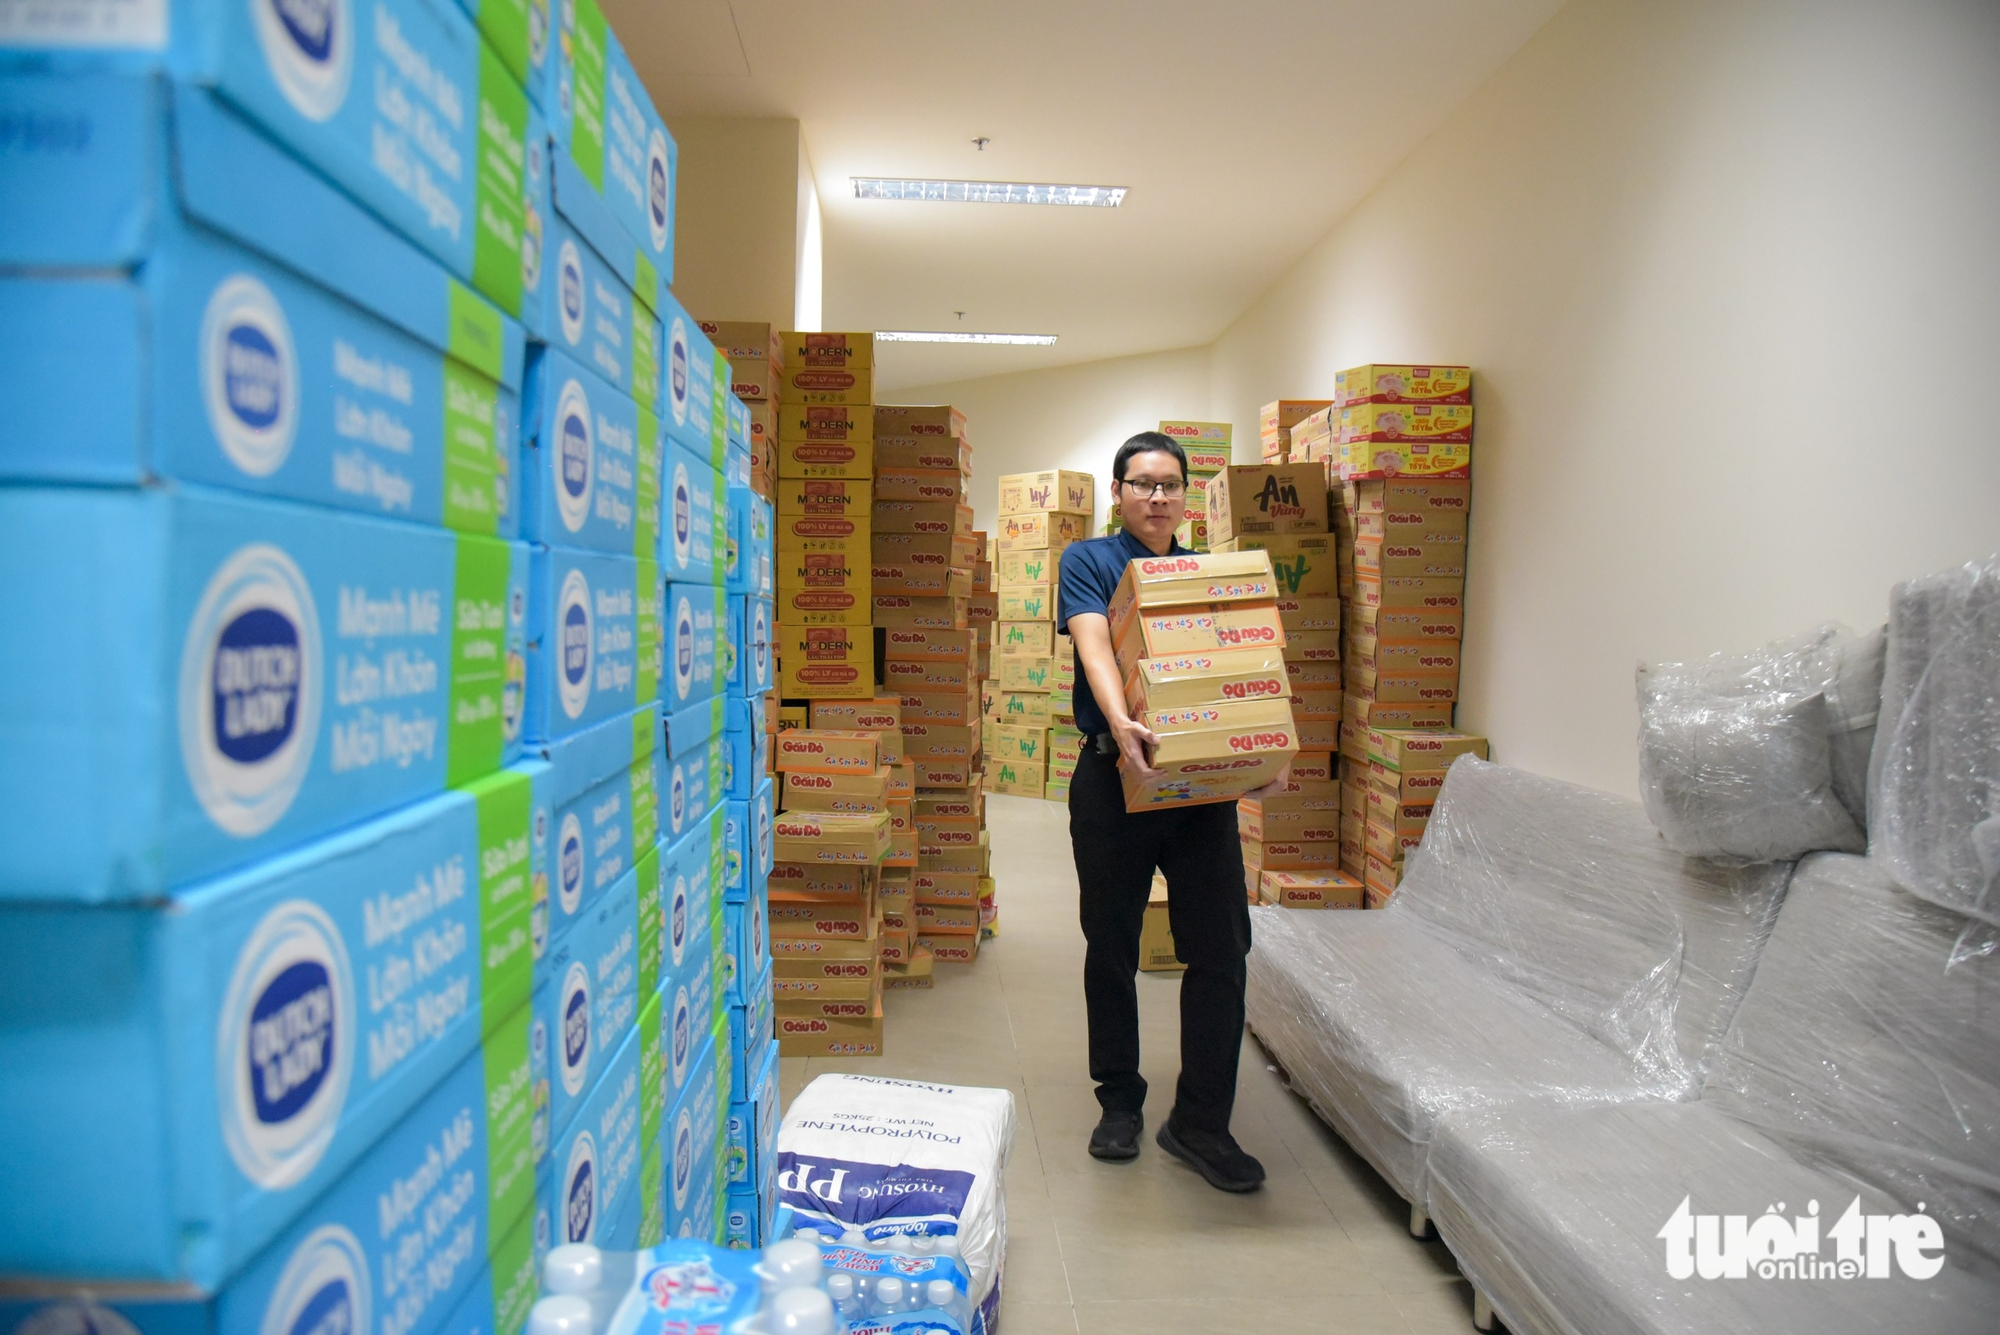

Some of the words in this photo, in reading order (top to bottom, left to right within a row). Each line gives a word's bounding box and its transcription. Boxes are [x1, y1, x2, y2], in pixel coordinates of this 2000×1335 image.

[799, 347, 852, 356] MODERN
[800, 420, 853, 430] MODERN
[1164, 426, 1184, 435] Gấu
[1186, 426, 1198, 436] Đỏ
[798, 450, 817, 458] 100%
[1192, 456, 1204, 466] Đỏ
[1206, 458, 1225, 466] Gấu
[1254, 474, 1300, 512] An
[798, 494, 850, 504] MODERN
[1430, 498, 1440, 506] Đỏ
[1444, 498, 1463, 507] Gấu
[1184, 510, 1205, 520] Gấu
[1388, 514, 1408, 523] Gấu
[1410, 514, 1422, 523] Đỏ
[1387, 548, 1407, 556] Gấu
[1409, 548, 1421, 556] Đỏ
[1142, 560, 1176, 574] Gấu
[1177, 558, 1199, 571] Đỏ
[798, 568, 851, 577] MODERN
[1208, 587, 1222, 596] Gà
[1226, 585, 1242, 595] Sợi
[1245, 583, 1266, 593] Phở
[1152, 621, 1173, 631] Phở
[1176, 619, 1193, 628] Sợi
[1197, 618, 1211, 628] Gà
[891, 633, 912, 643] Gấu
[912, 632, 925, 643] Đỏ
[1218, 630, 1241, 643] Đỏ
[1241, 627, 1275, 641] Gấu
[800, 642, 852, 650] MODERN
[1150, 662, 1172, 672] Phở
[1175, 659, 1192, 669] Sợi
[1196, 658, 1211, 668] Gà
[217, 644, 298, 698] DUTCH
[890, 664, 910, 673] Gấu
[911, 664, 924, 674] Đỏ
[1222, 683, 1245, 698] Đỏ
[1246, 679, 1281, 696] Gấu
[224, 693, 291, 738] LADY
[1156, 715, 1178, 726] Phở
[1181, 712, 1199, 722] Sợi
[1203, 711, 1218, 720] Gà
[858, 716, 873, 726] Đỏ
[875, 716, 894, 726] Gấu
[1229, 736, 1252, 752] Đỏ
[1254, 732, 1288, 748] Gấu
[783, 741, 808, 753] Gấu
[808, 742, 824, 753] Đỏ
[1407, 741, 1427, 750] Gấu
[1429, 741, 1442, 749] Đỏ
[791, 777, 813, 788] Gấu
[814, 777, 832, 788] Đỏ
[1409, 778, 1429, 787] Gấu
[1430, 777, 1443, 786] Đỏ
[777, 824, 803, 836] Gấu
[804, 824, 821, 836] Đỏ
[787, 867, 804, 878] Đỏ
[1288, 891, 1308, 900] Gấu
[1309, 891, 1322, 900] Đỏ
[815, 921, 832, 933] Đỏ
[833, 921, 859, 932] Gấu
[824, 965, 841, 976] Đỏ
[842, 965, 868, 976] Gấu
[823, 1005, 840, 1015] Đỏ
[841, 1005, 866, 1015] Gấu
[252, 985, 330, 1065] DUTCH
[784, 1021, 809, 1032] Gấu
[810, 1021, 828, 1032] Đỏ
[264, 1027, 327, 1104] LADY
[843, 1075, 953, 1094] HYOSUNG
[833, 1113, 873, 1121] 25KGS
[909, 1118, 934, 1126] NET
[796, 1120, 962, 1144] POLYPROPYLENE
[778, 1164, 850, 1204] PP
[873, 1222, 929, 1236] Topilene
